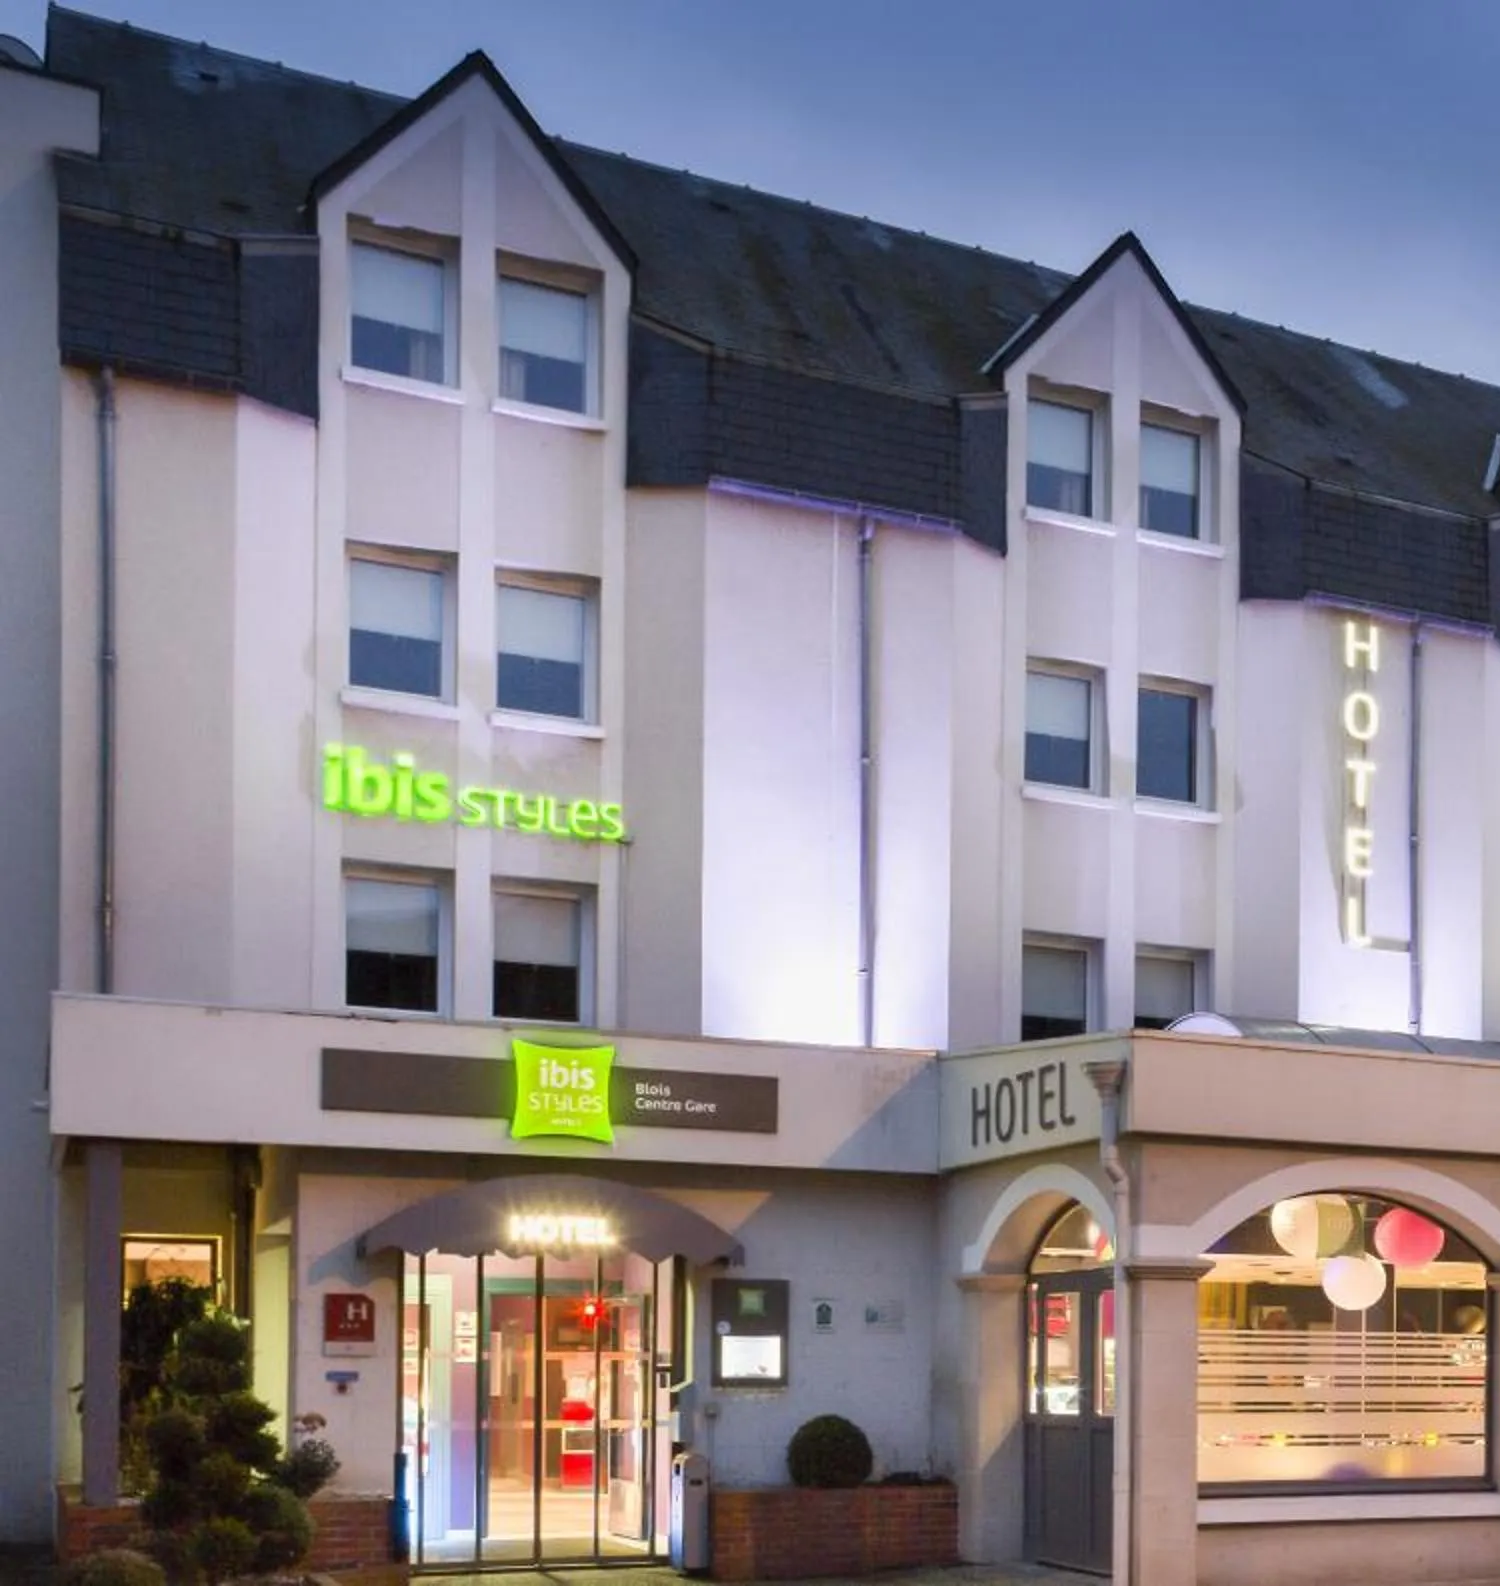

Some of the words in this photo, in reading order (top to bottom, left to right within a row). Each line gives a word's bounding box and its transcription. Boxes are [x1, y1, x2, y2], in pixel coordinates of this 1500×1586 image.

[323, 740, 452, 824] ibis
[1343, 619, 1380, 950] HOTEL
[539, 1058, 596, 1091] ibis
[634, 1083, 671, 1098] Blois
[634, 1098, 682, 1113] Centre
[684, 1099, 717, 1114] Gare
[970, 1060, 1077, 1149] HOTEL
[508, 1213, 618, 1245] HOTEL
[346, 1301, 368, 1322] H
